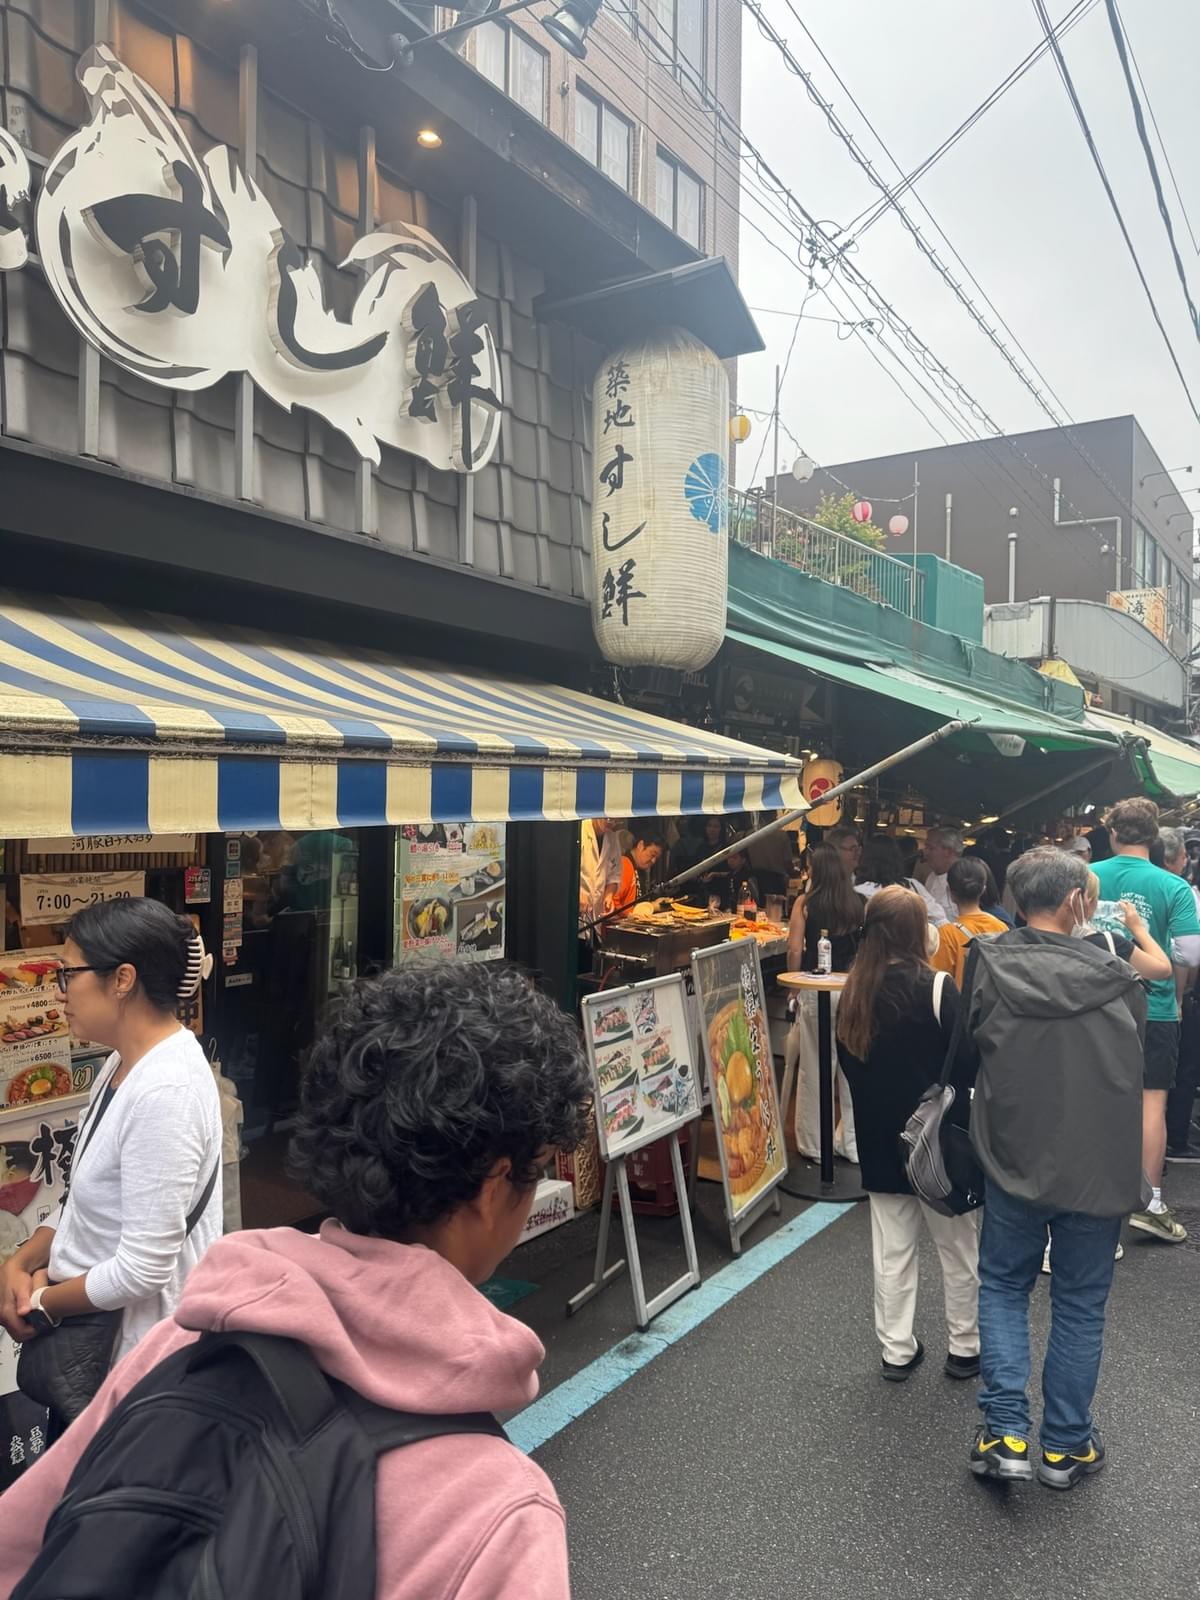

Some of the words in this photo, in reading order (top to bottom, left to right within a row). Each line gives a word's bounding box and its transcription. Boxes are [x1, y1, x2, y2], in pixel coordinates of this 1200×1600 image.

[599, 361, 647, 626] 築地すし鮮
